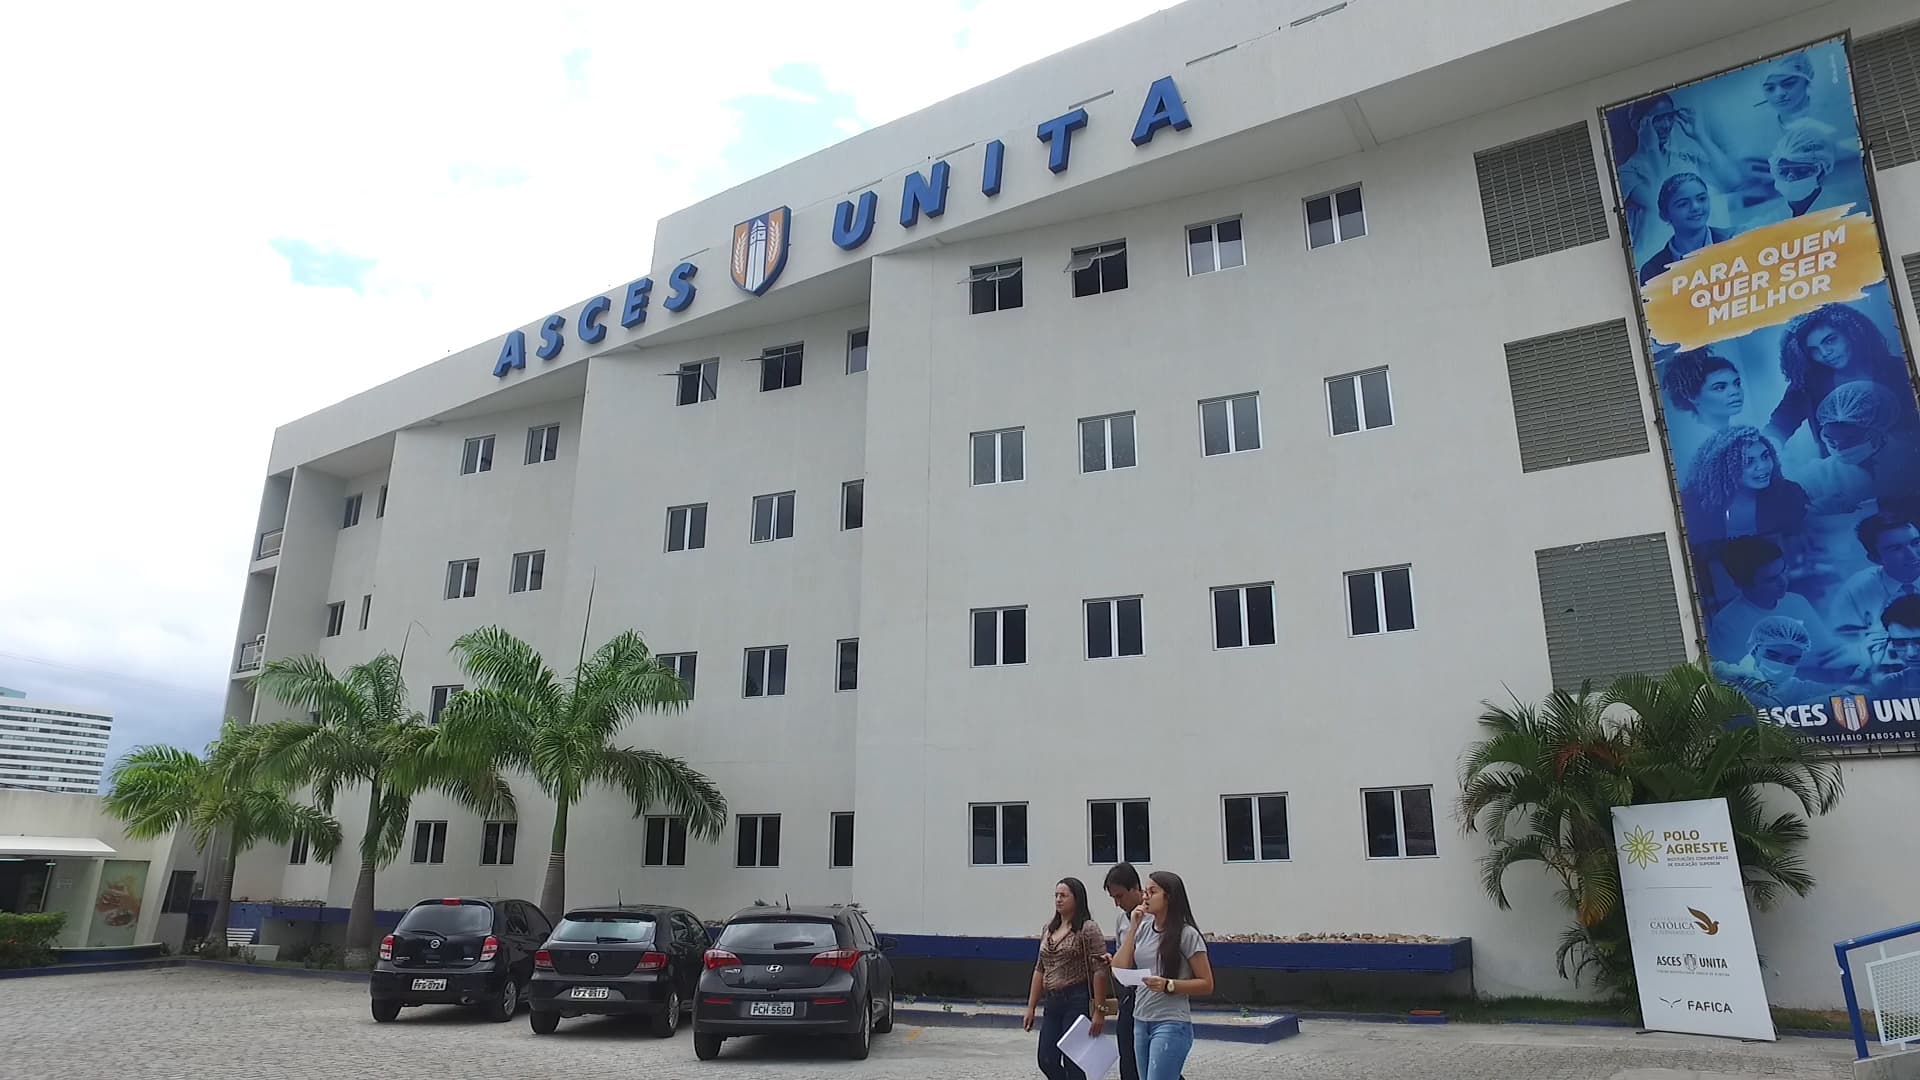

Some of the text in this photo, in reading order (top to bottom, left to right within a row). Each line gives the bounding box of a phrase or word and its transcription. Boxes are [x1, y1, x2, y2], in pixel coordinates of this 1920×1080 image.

[493, 75, 1192, 377] ASCES UNITA
[1671, 224, 1847, 296] PARA QUEM
[1690, 251, 1838, 309] QUER SER
[1708, 274, 1831, 326] MELHOR
[1872, 697, 1920, 723] UNI
[1865, 731, 1901, 740] TABOSA
[1663, 830, 1700, 841] POLO
[1666, 841, 1729, 855] AGRESTE
[1649, 919, 1696, 930] CATÓLICA
[1656, 955, 1728, 969] ASCES UNITA
[1687, 1000, 1733, 1014] FAFICA
